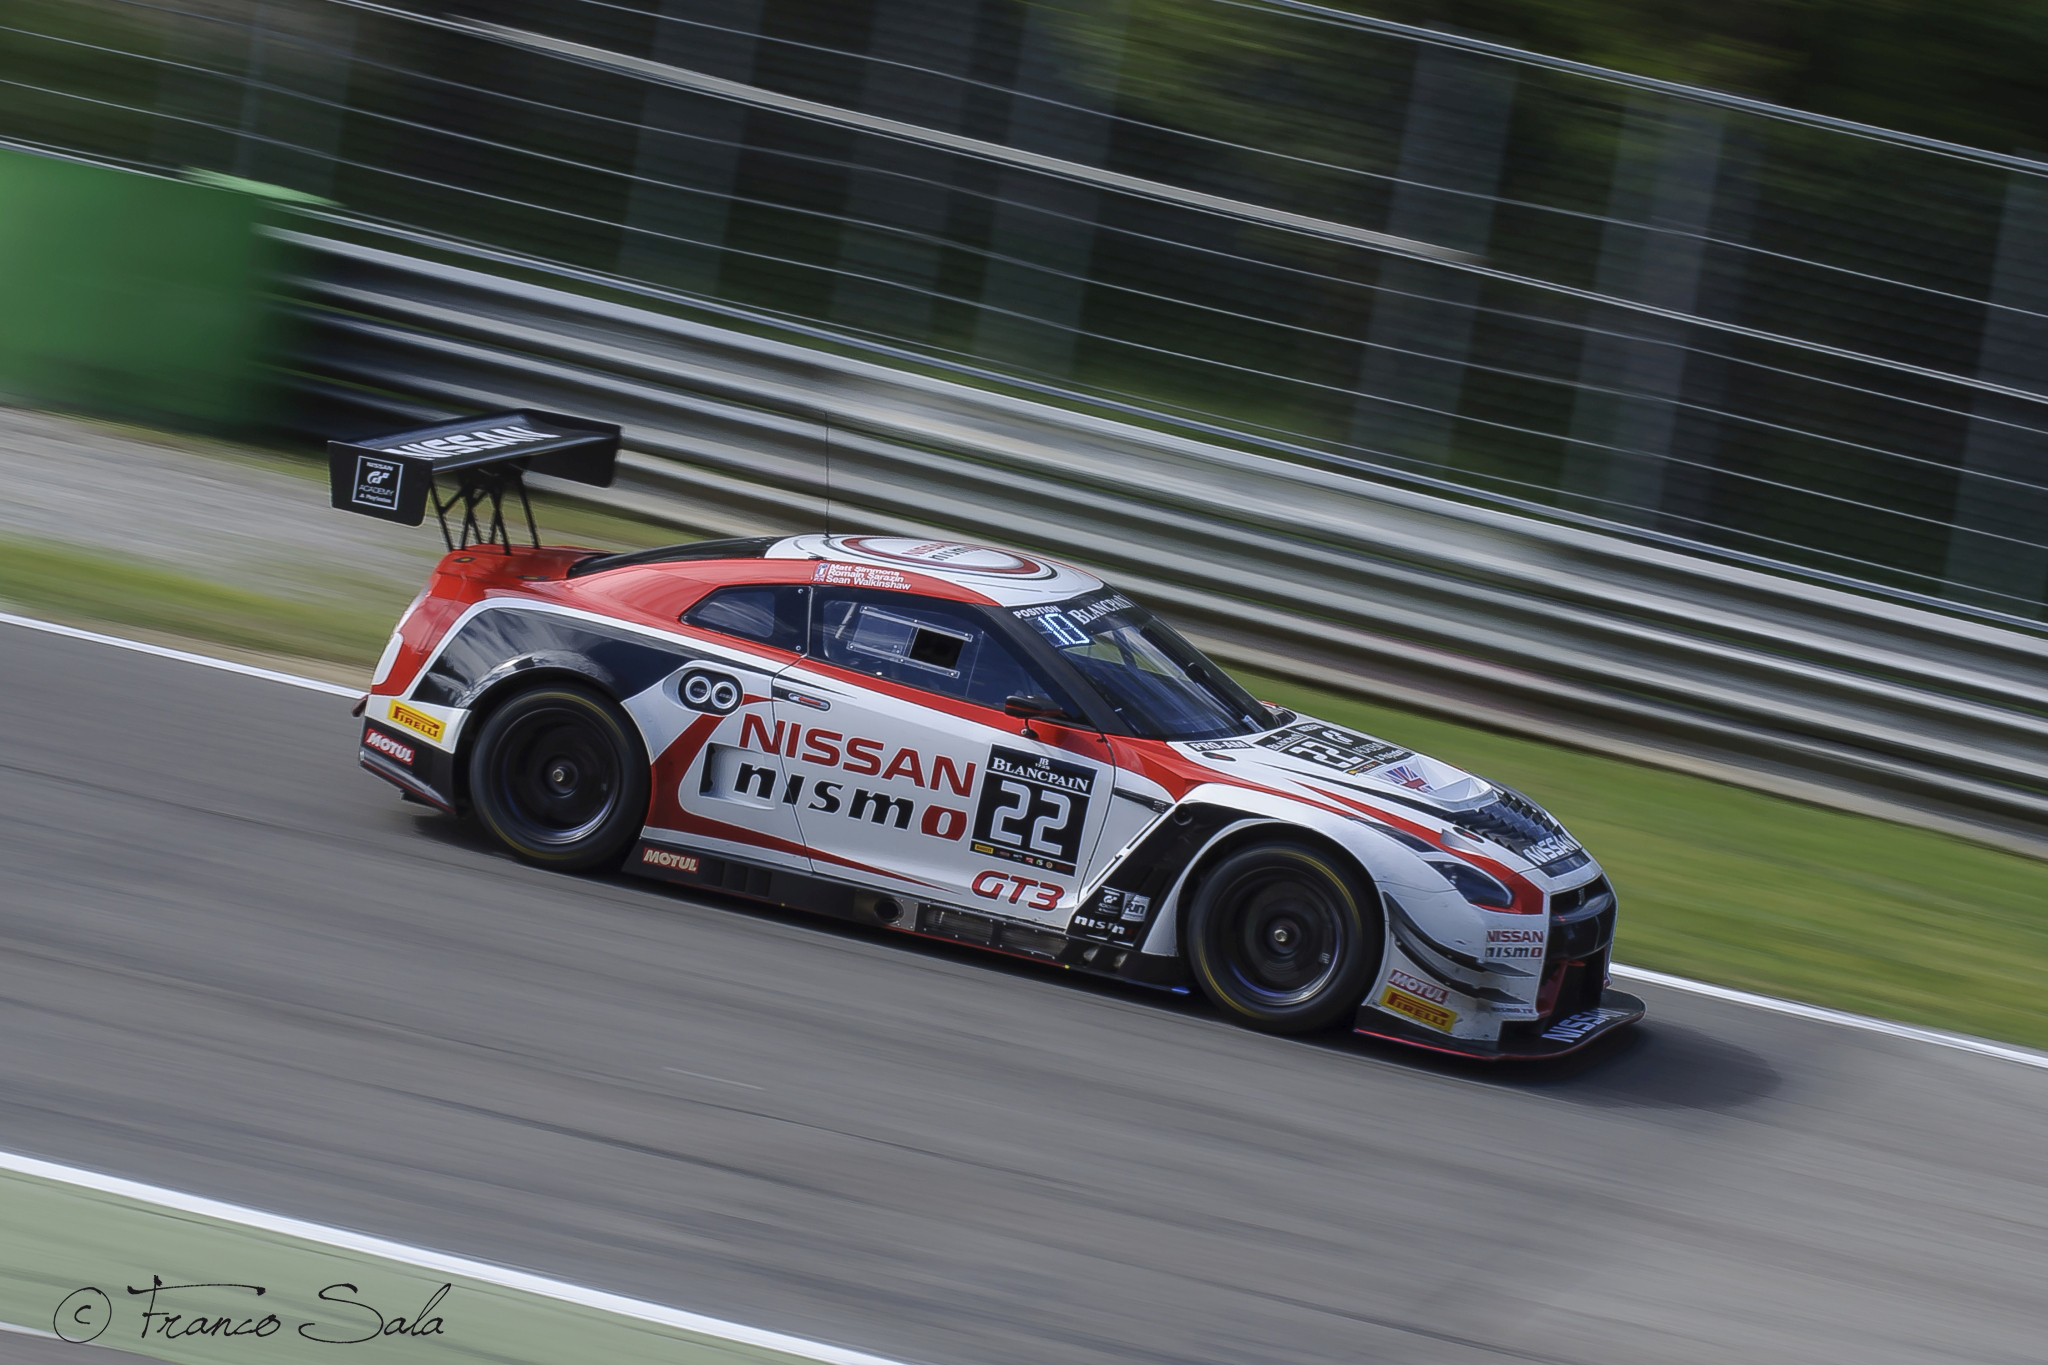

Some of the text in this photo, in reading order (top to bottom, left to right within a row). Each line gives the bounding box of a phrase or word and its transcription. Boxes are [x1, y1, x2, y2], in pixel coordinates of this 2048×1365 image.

[381, 426, 562, 461] NISSAN
[825, 575, 911, 591] Sean Walkinshaw
[827, 568, 865, 579] Romain
[1012, 605, 1062, 619] POSITION
[1067, 594, 1135, 626] BLANCPAIN
[1037, 612, 1091, 646] 10
[393, 705, 440, 738] PIRELLI
[366, 731, 413, 763] MOTUL
[738, 711, 978, 799] NISSAN
[1190, 740, 1251, 751] PRO-AM
[1288, 740, 1365, 769] 22
[991, 756, 1091, 792] BLANCPAIN
[732, 760, 970, 843] nismo
[989, 779, 1071, 856] 22
[643, 849, 698, 873] MOTUL
[1522, 833, 1580, 866] NISSAN
[970, 869, 1066, 912] GT3
[1486, 930, 1544, 943] NISSAN
[1391, 970, 1445, 1003] MOTUL
[1387, 991, 1450, 1027] PIRELLI
[1541, 1006, 1631, 1043] NISSAN
